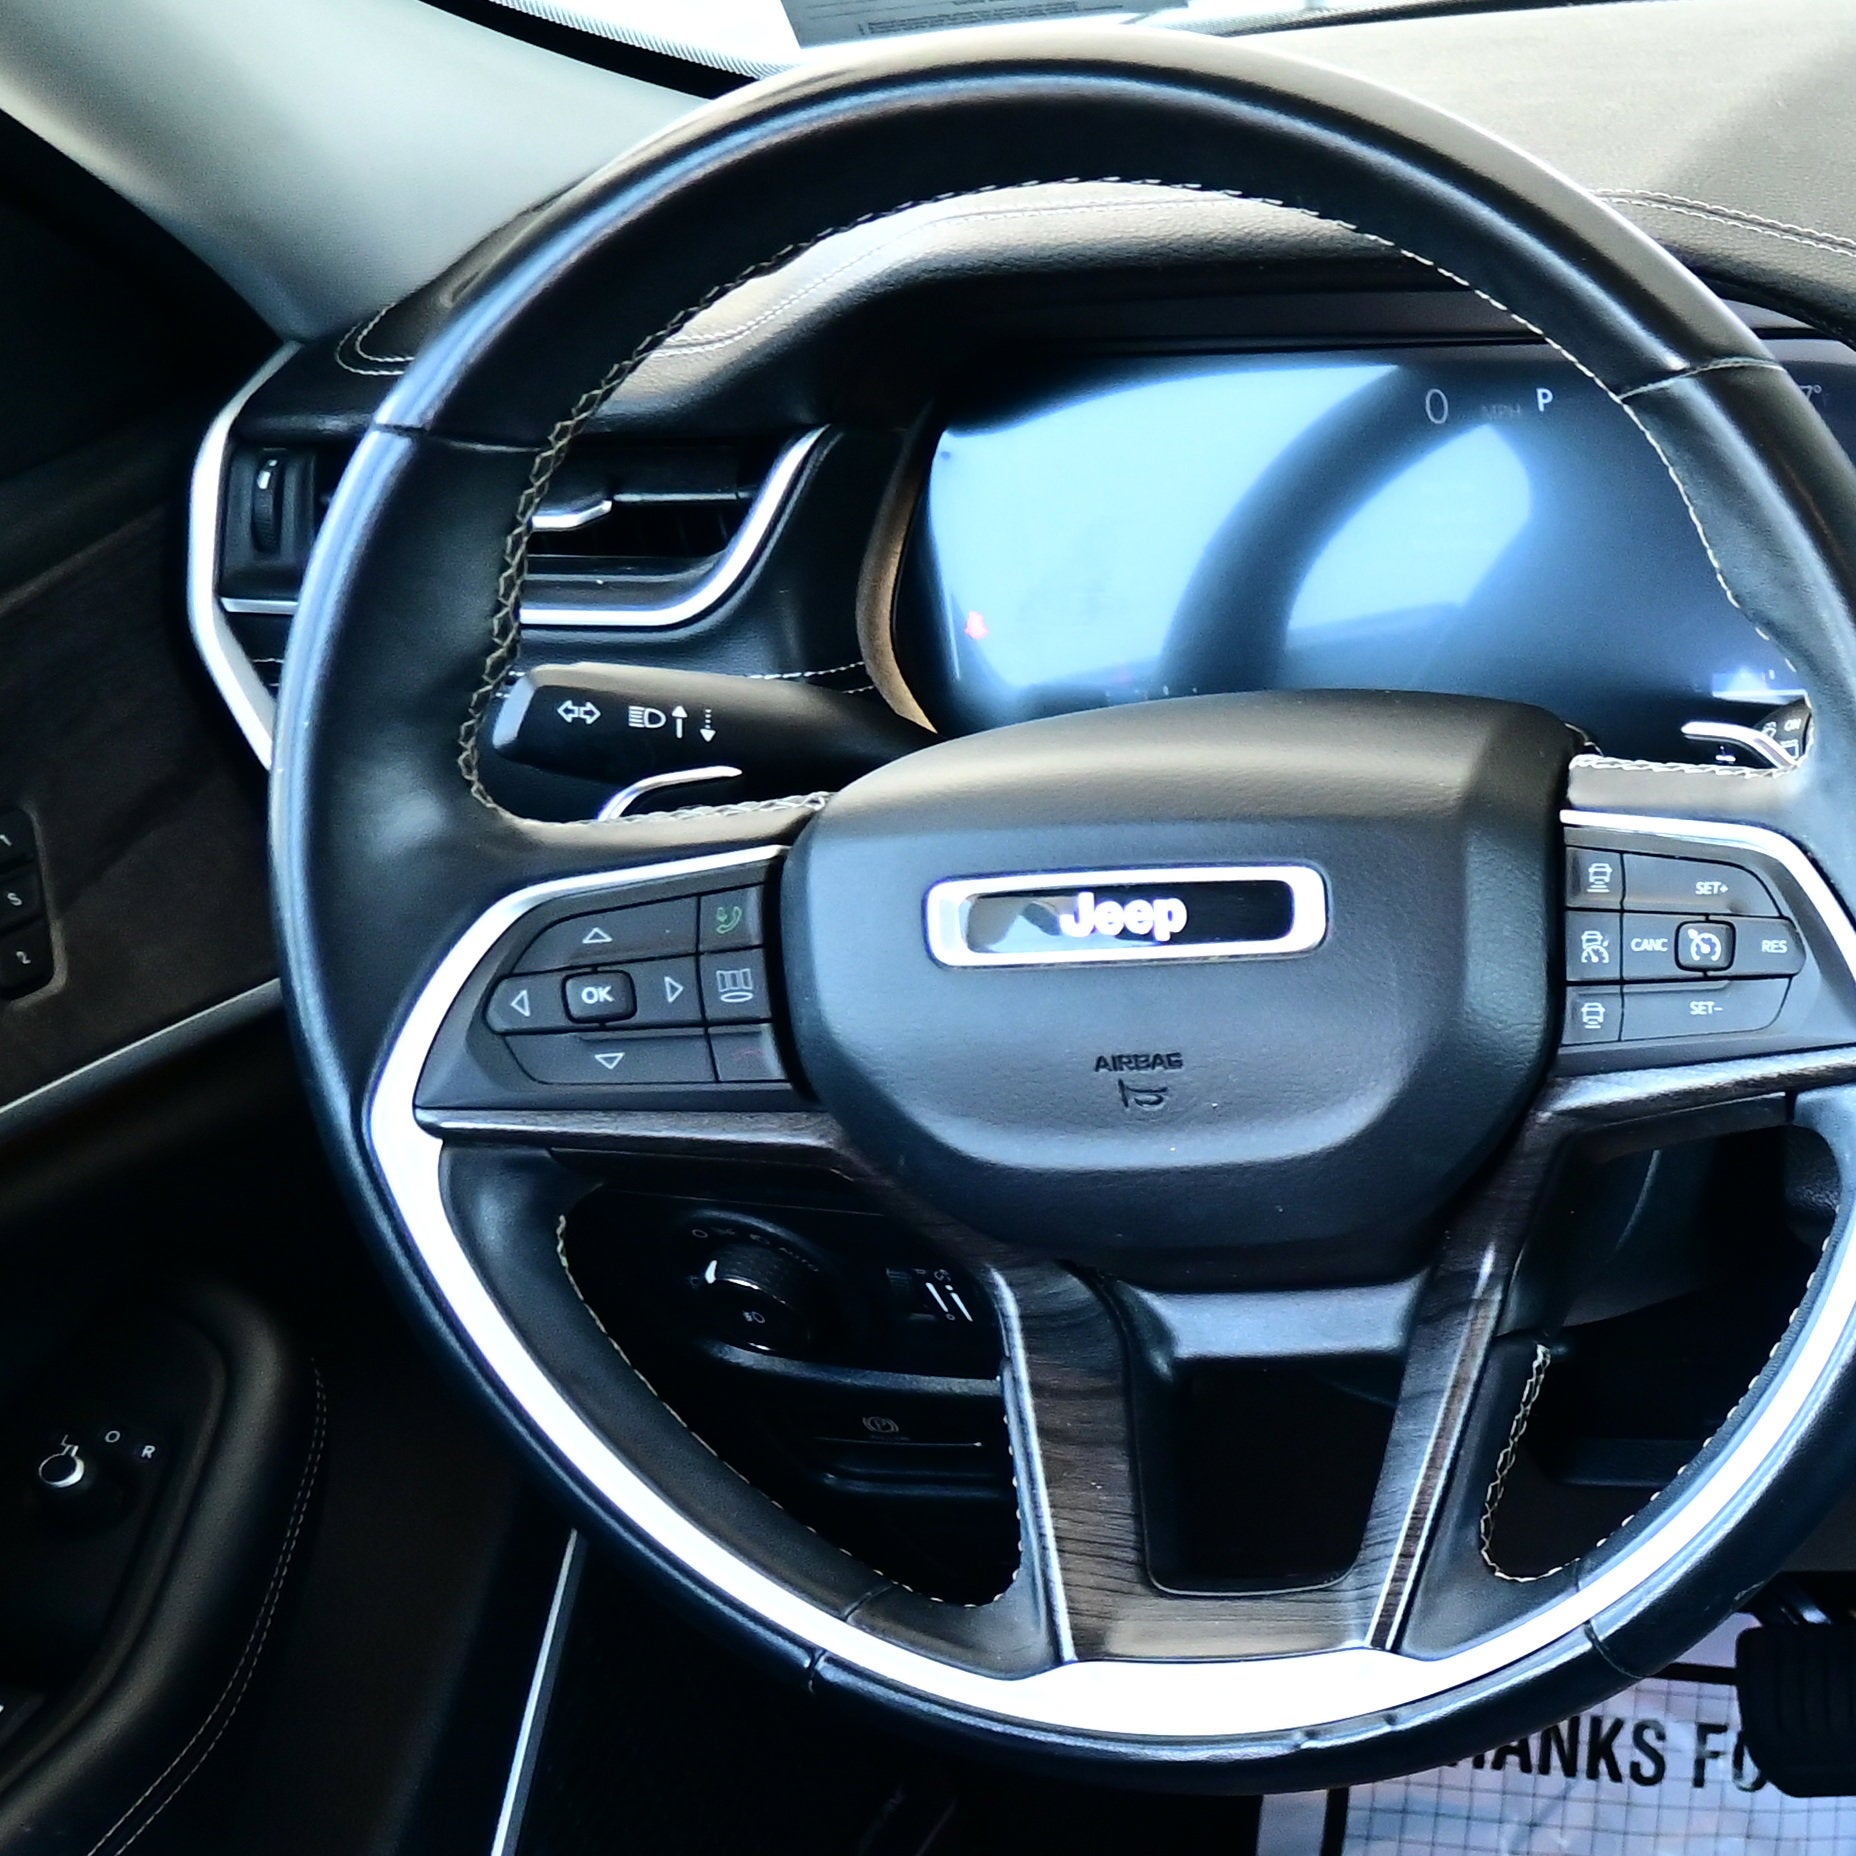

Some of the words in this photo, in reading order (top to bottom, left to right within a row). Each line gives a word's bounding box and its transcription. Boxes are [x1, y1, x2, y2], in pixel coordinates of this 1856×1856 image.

[1535, 388, 1553, 412] P
[1059, 892, 1188, 942] Jeep
[1631, 937, 1669, 952] CANC
[1761, 939, 1788, 954] RES
[581, 984, 613, 1004] OK
[1093, 1051, 1184, 1074] AIRBAG
[140, 1444, 157, 1459] R
[1444, 1715, 1666, 1786] ANKS
